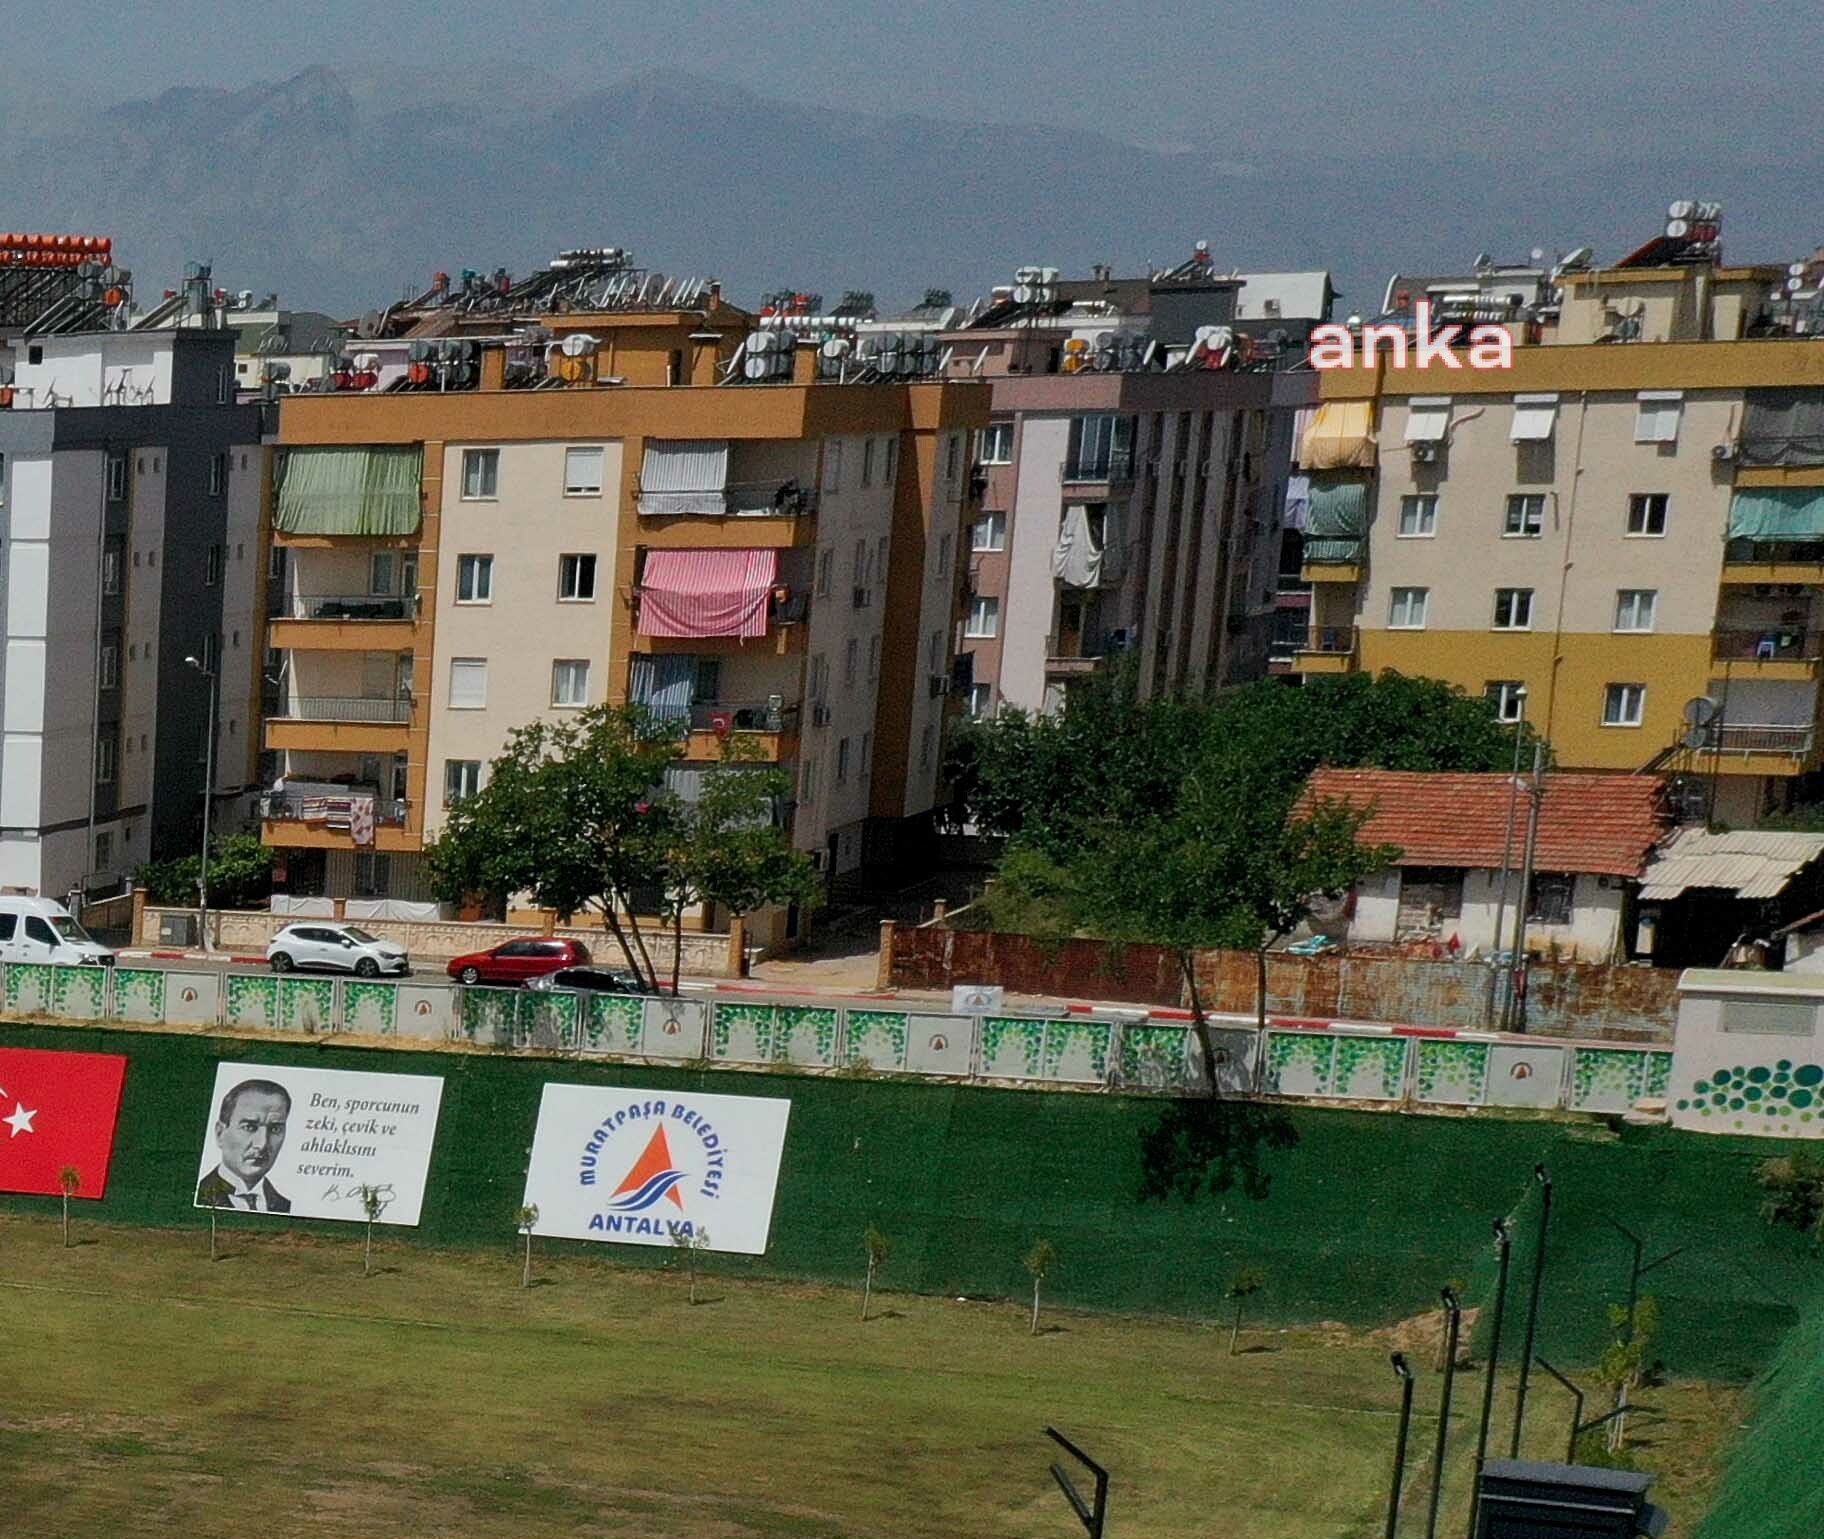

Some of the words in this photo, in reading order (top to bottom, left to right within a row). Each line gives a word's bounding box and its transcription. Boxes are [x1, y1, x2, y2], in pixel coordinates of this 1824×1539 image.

[309, 1092, 341, 1112] Ben,
[344, 1098, 420, 1115] sporcunun
[305, 1116, 338, 1133] zeki,
[342, 1118, 379, 1136] çevik
[381, 1125, 397, 1136] ve
[300, 1137, 377, 1157] ahlaklısını
[580, 1100, 667, 1186] MURATPAŞA
[671, 1103, 728, 1199] BELEDİYESİ
[296, 1162, 355, 1178] severim.
[588, 1213, 695, 1238] ANTALYA
